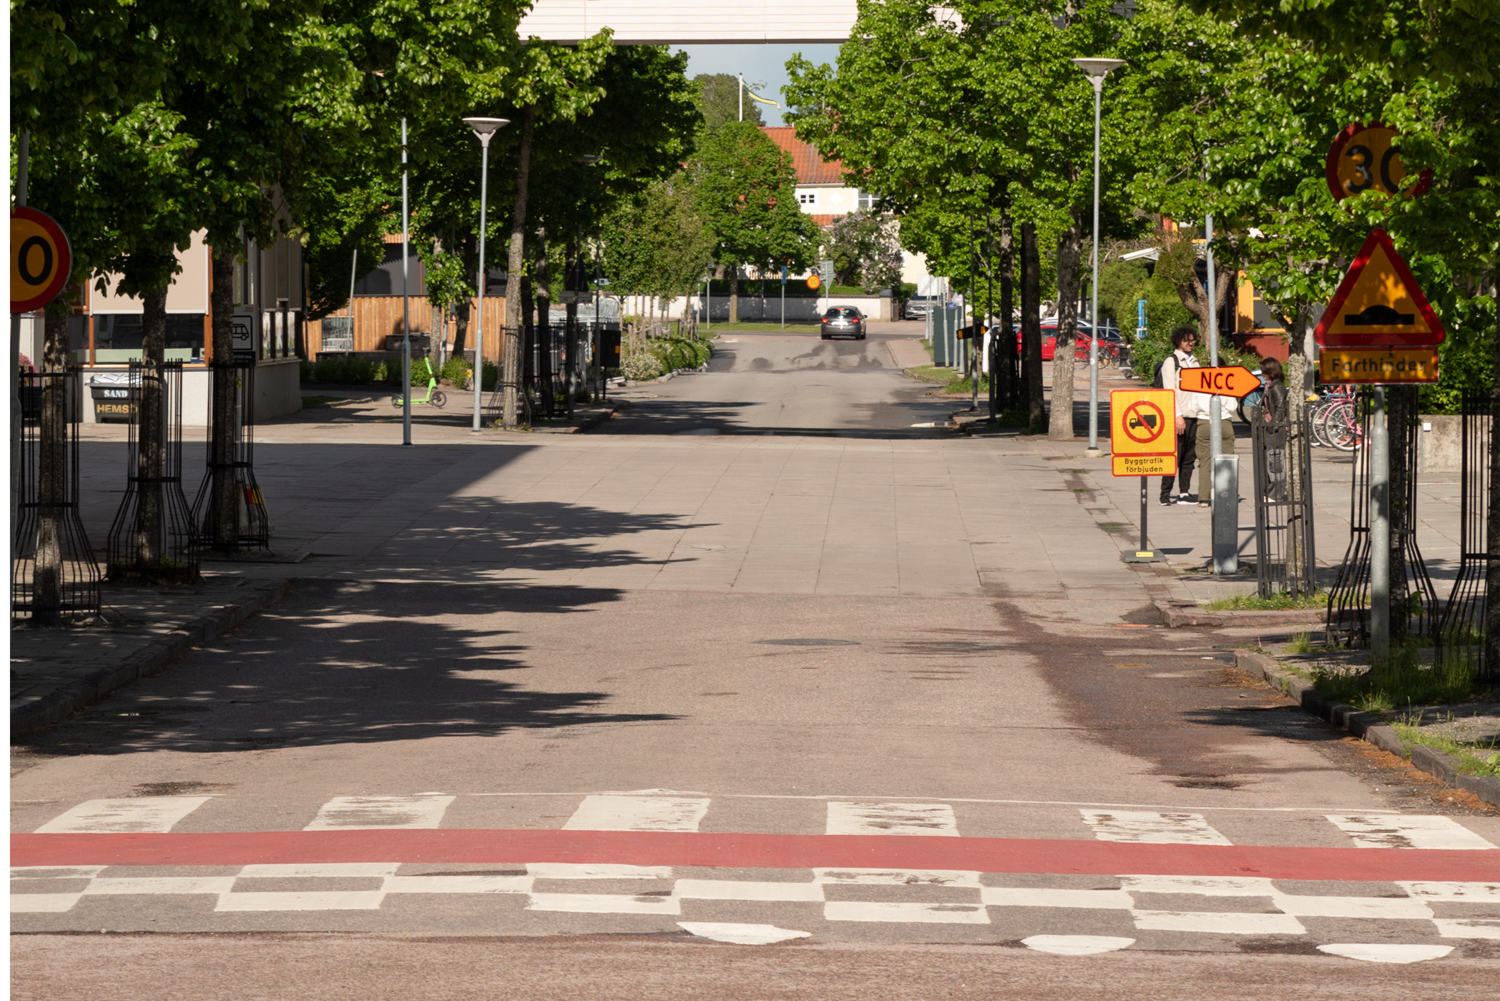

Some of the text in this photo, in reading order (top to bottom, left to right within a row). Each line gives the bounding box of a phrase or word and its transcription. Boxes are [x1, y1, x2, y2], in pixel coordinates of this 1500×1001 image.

[10, 235, 53, 286] 0
[1332, 357, 1427, 374] Farthinder
[1200, 371, 1235, 391] NCC
[104, 389, 128, 398] SAND
[1124, 457, 1164, 466] Byggtrafik
[1125, 466, 1163, 474] förbjuden
